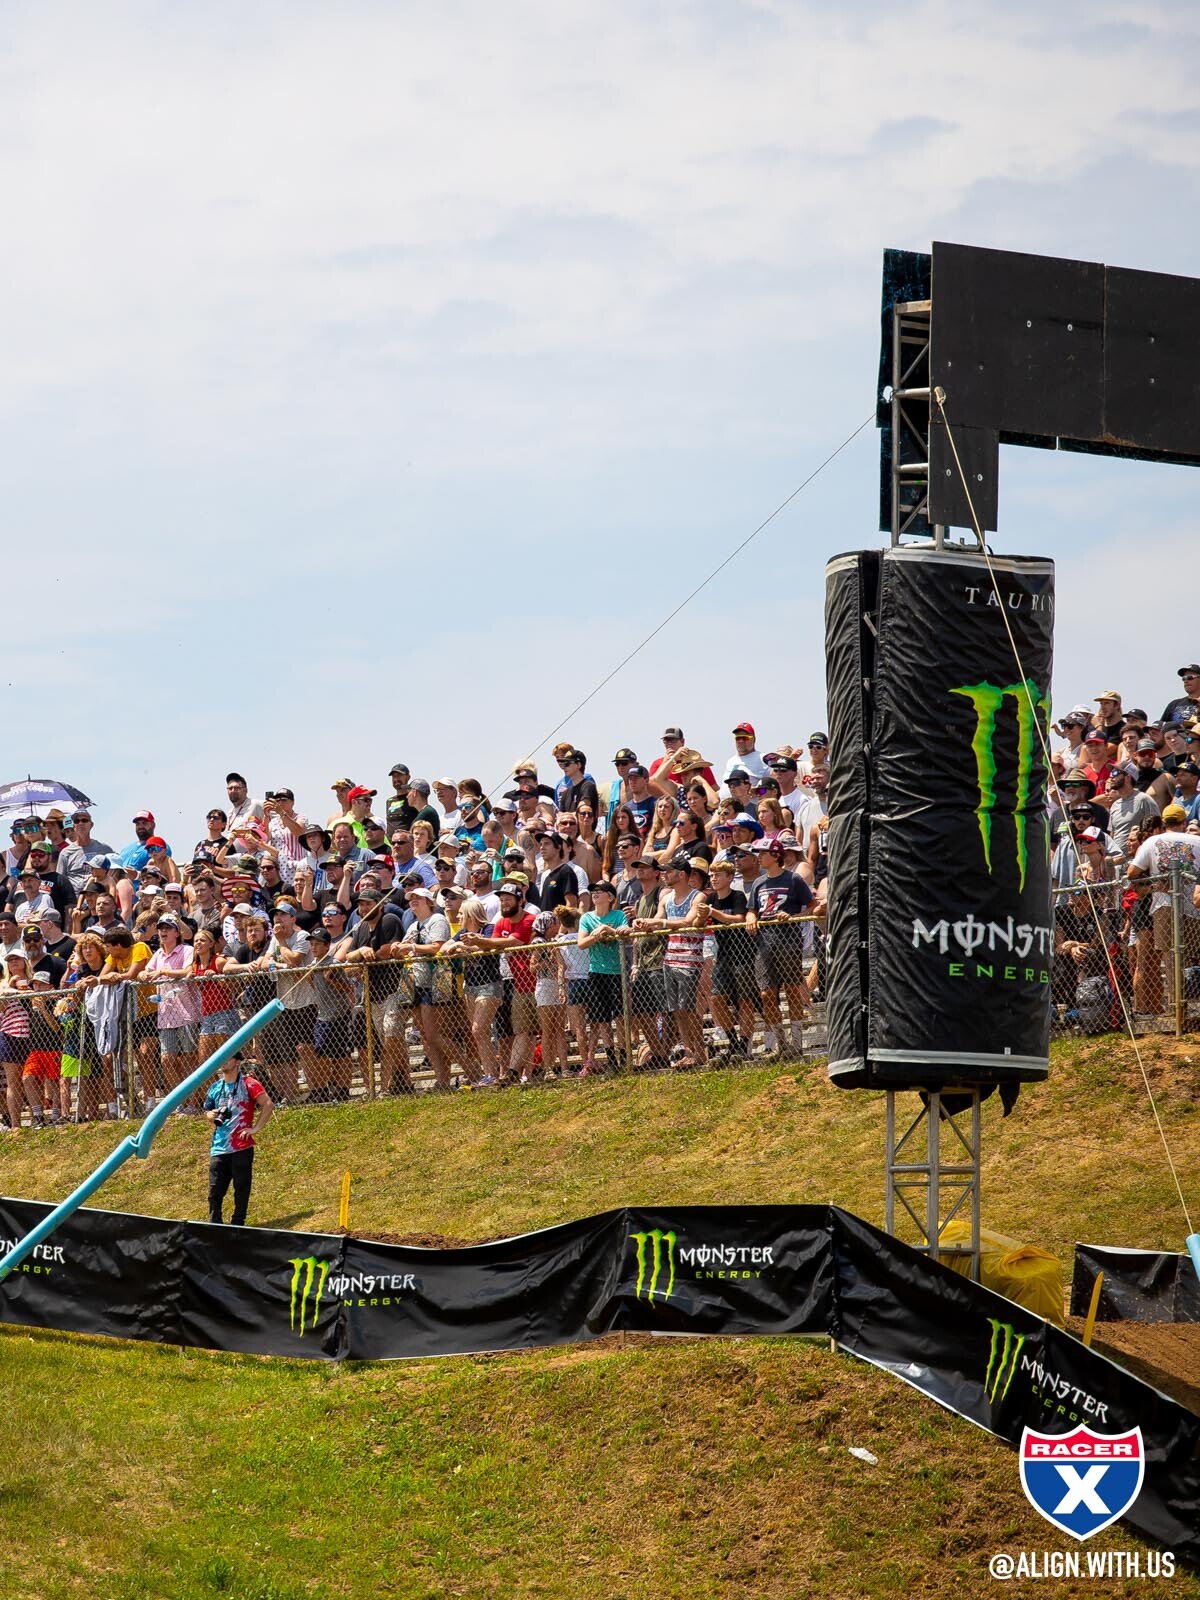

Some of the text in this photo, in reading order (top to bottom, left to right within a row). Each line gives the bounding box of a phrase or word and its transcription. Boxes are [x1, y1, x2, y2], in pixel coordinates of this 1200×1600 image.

[679, 1244, 774, 1268] MONSTER
[328, 1272, 417, 1297] MONSTER
[695, 1270, 762, 1279] ENERGY
[343, 1296, 402, 1307] NERGY
[1020, 1354, 1109, 1424] MONSTER
[1031, 1384, 1091, 1425] EERGY
